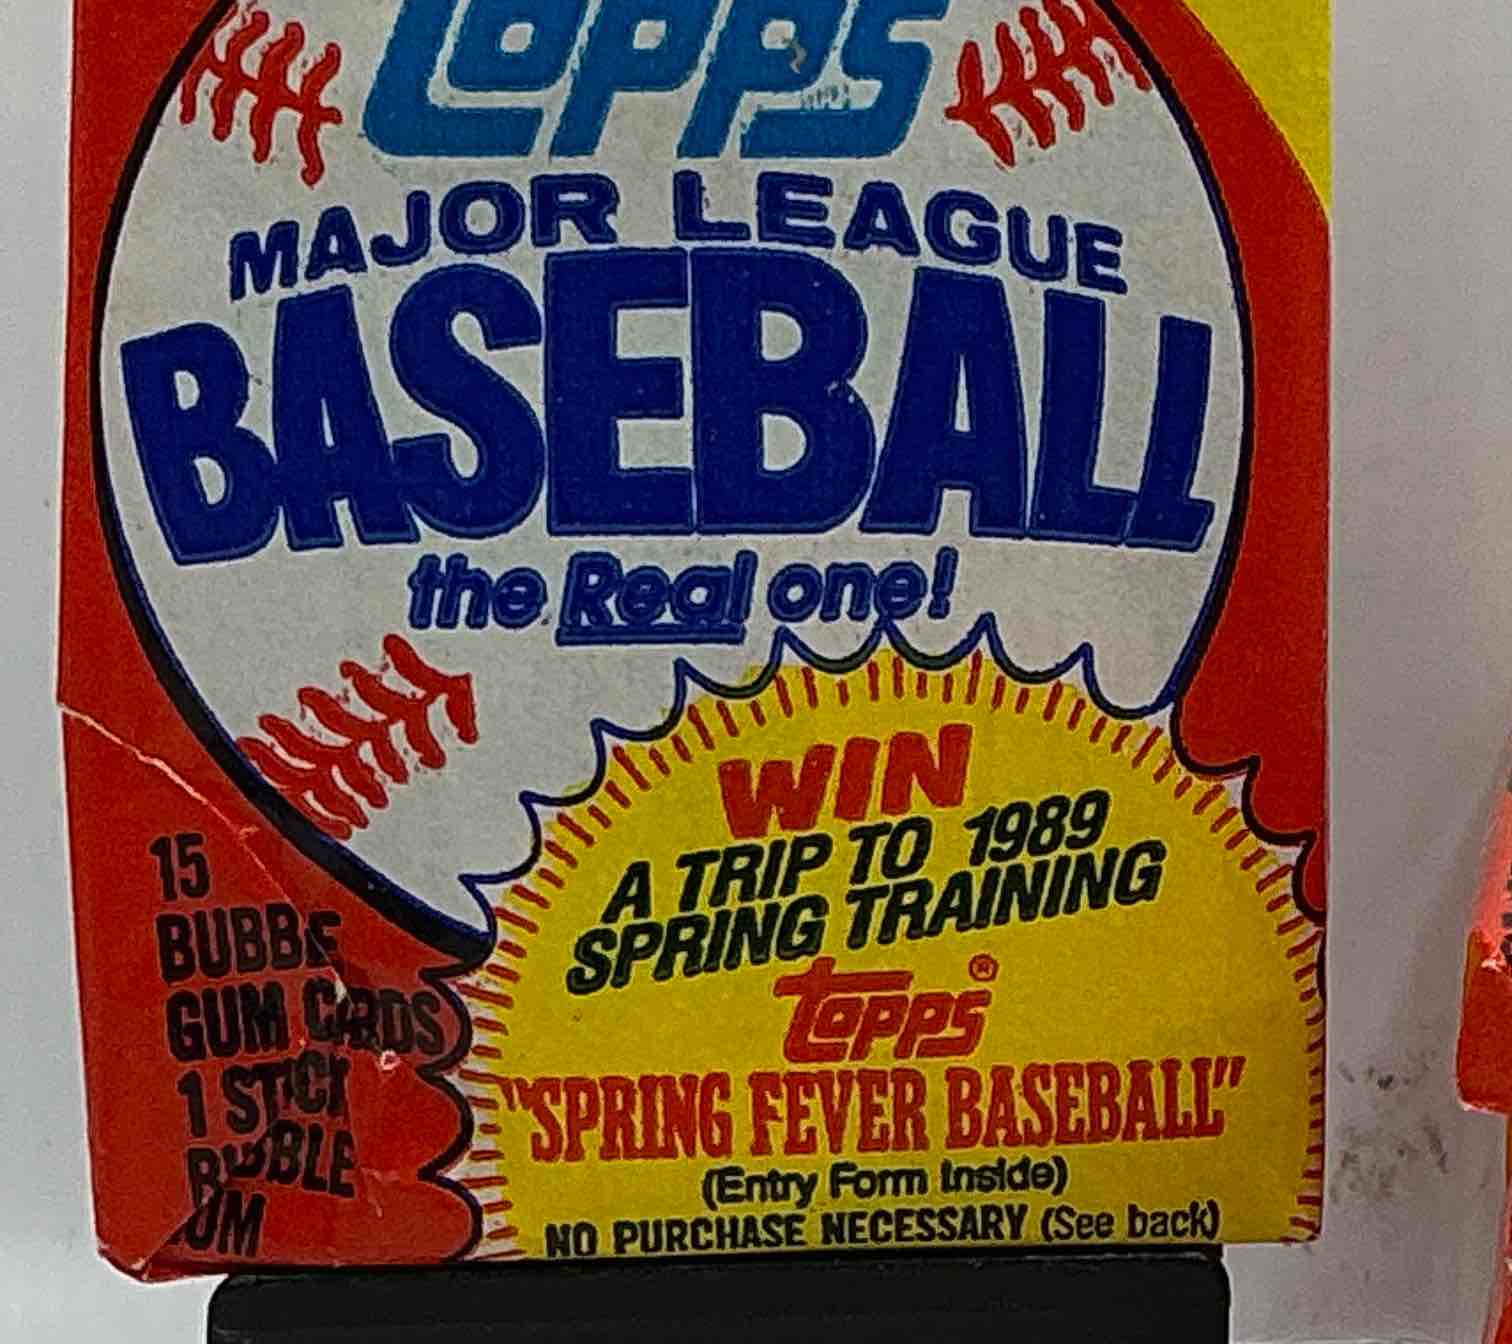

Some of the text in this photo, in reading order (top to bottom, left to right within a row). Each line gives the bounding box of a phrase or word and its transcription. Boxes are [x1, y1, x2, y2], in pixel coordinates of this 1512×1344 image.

[228, 169, 1130, 300] MAJOR LEAGUE
[120, 248, 1215, 565] BASEBALL
[406, 547, 960, 644] the Real one!
[718, 723, 973, 838] WIN
[149, 832, 210, 901] 15
[601, 788, 1110, 922] A TRIP TO 1989
[565, 839, 1168, 994] SPRING TRAINING
[165, 981, 290, 1063] GUM
[177, 1069, 207, 1138] 1
[500, 1055, 1247, 1163] "SPRING FEVER BASEBALL"
[545, 1200, 1221, 1258] NO PURCHASE NECESSARY (See back)
[702, 1156, 1070, 1211] (Entry Form Inside)
